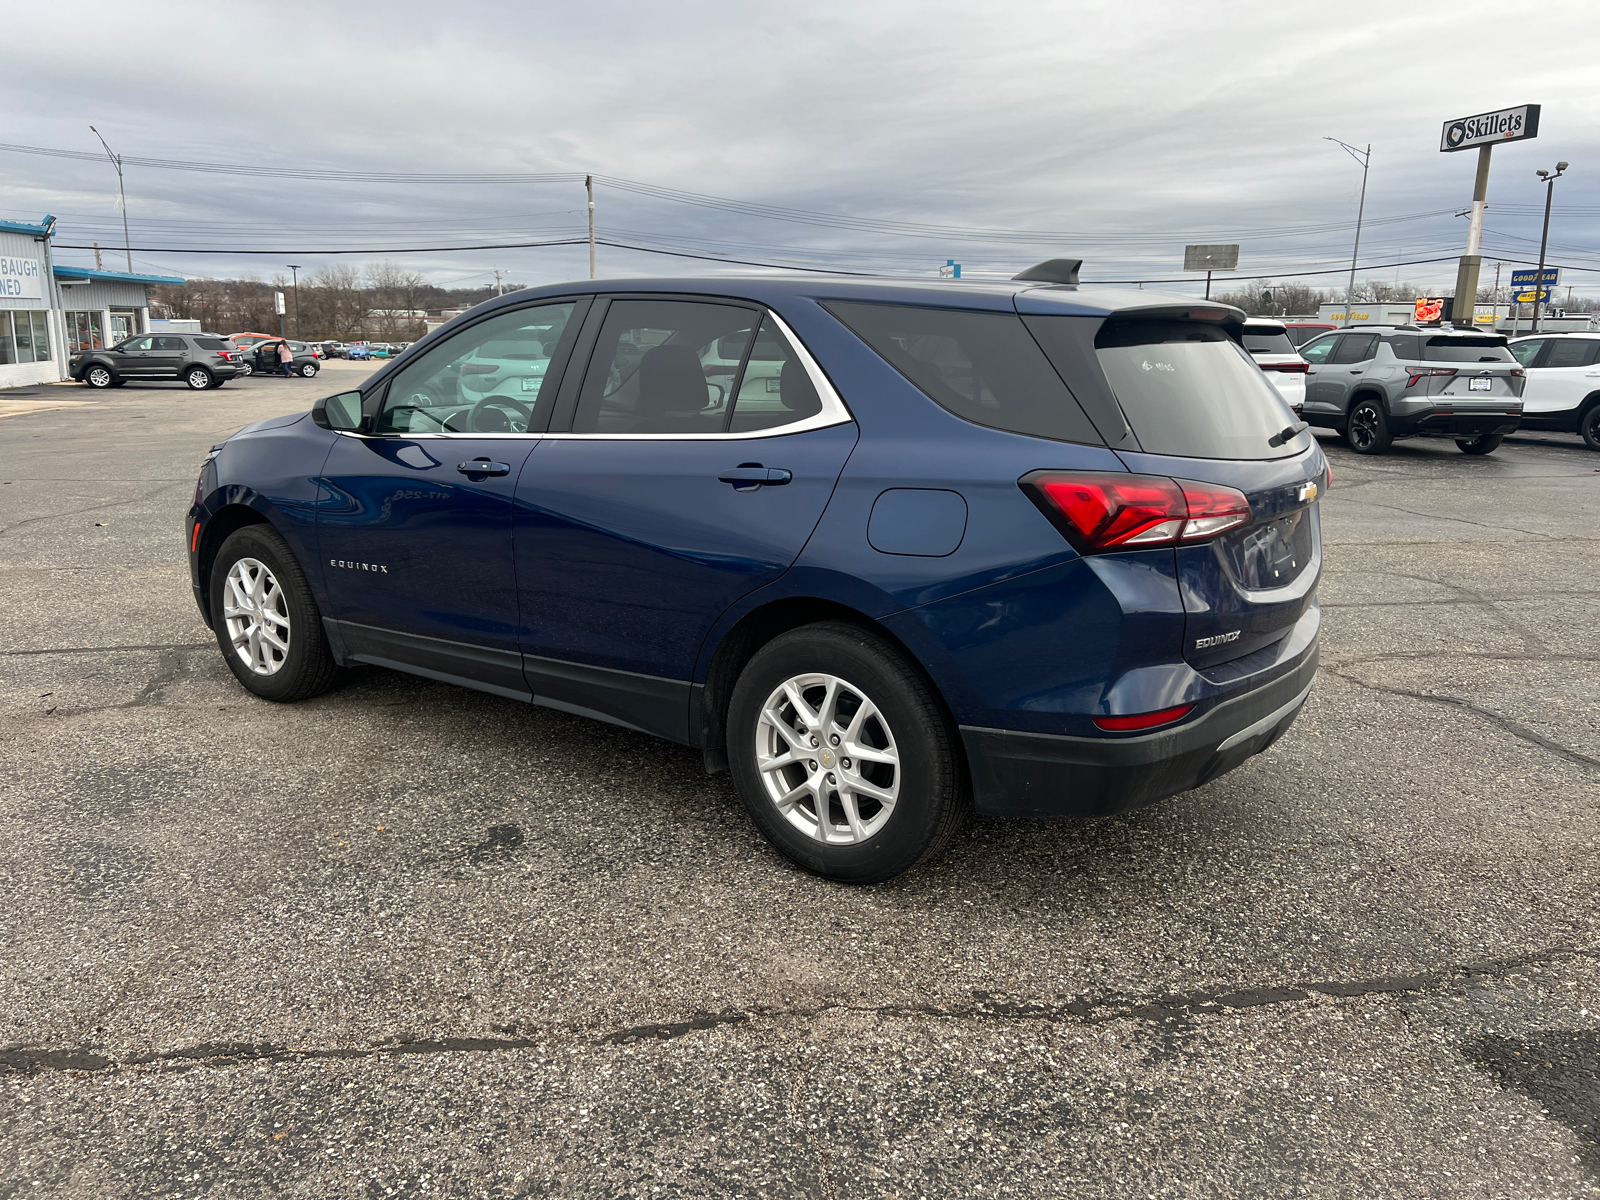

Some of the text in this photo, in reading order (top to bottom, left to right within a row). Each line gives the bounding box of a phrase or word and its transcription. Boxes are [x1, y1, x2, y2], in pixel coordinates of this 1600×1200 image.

[1466, 113, 1522, 140] Skillets
[0, 258, 38, 277] BAUGH
[1513, 272, 1556, 282] GOODEAR
[0, 278, 21, 295] NED
[1474, 307, 1498, 315] ERVICE
[330, 559, 388, 573] EQUINOX
[1195, 630, 1241, 650] EQUINOX
